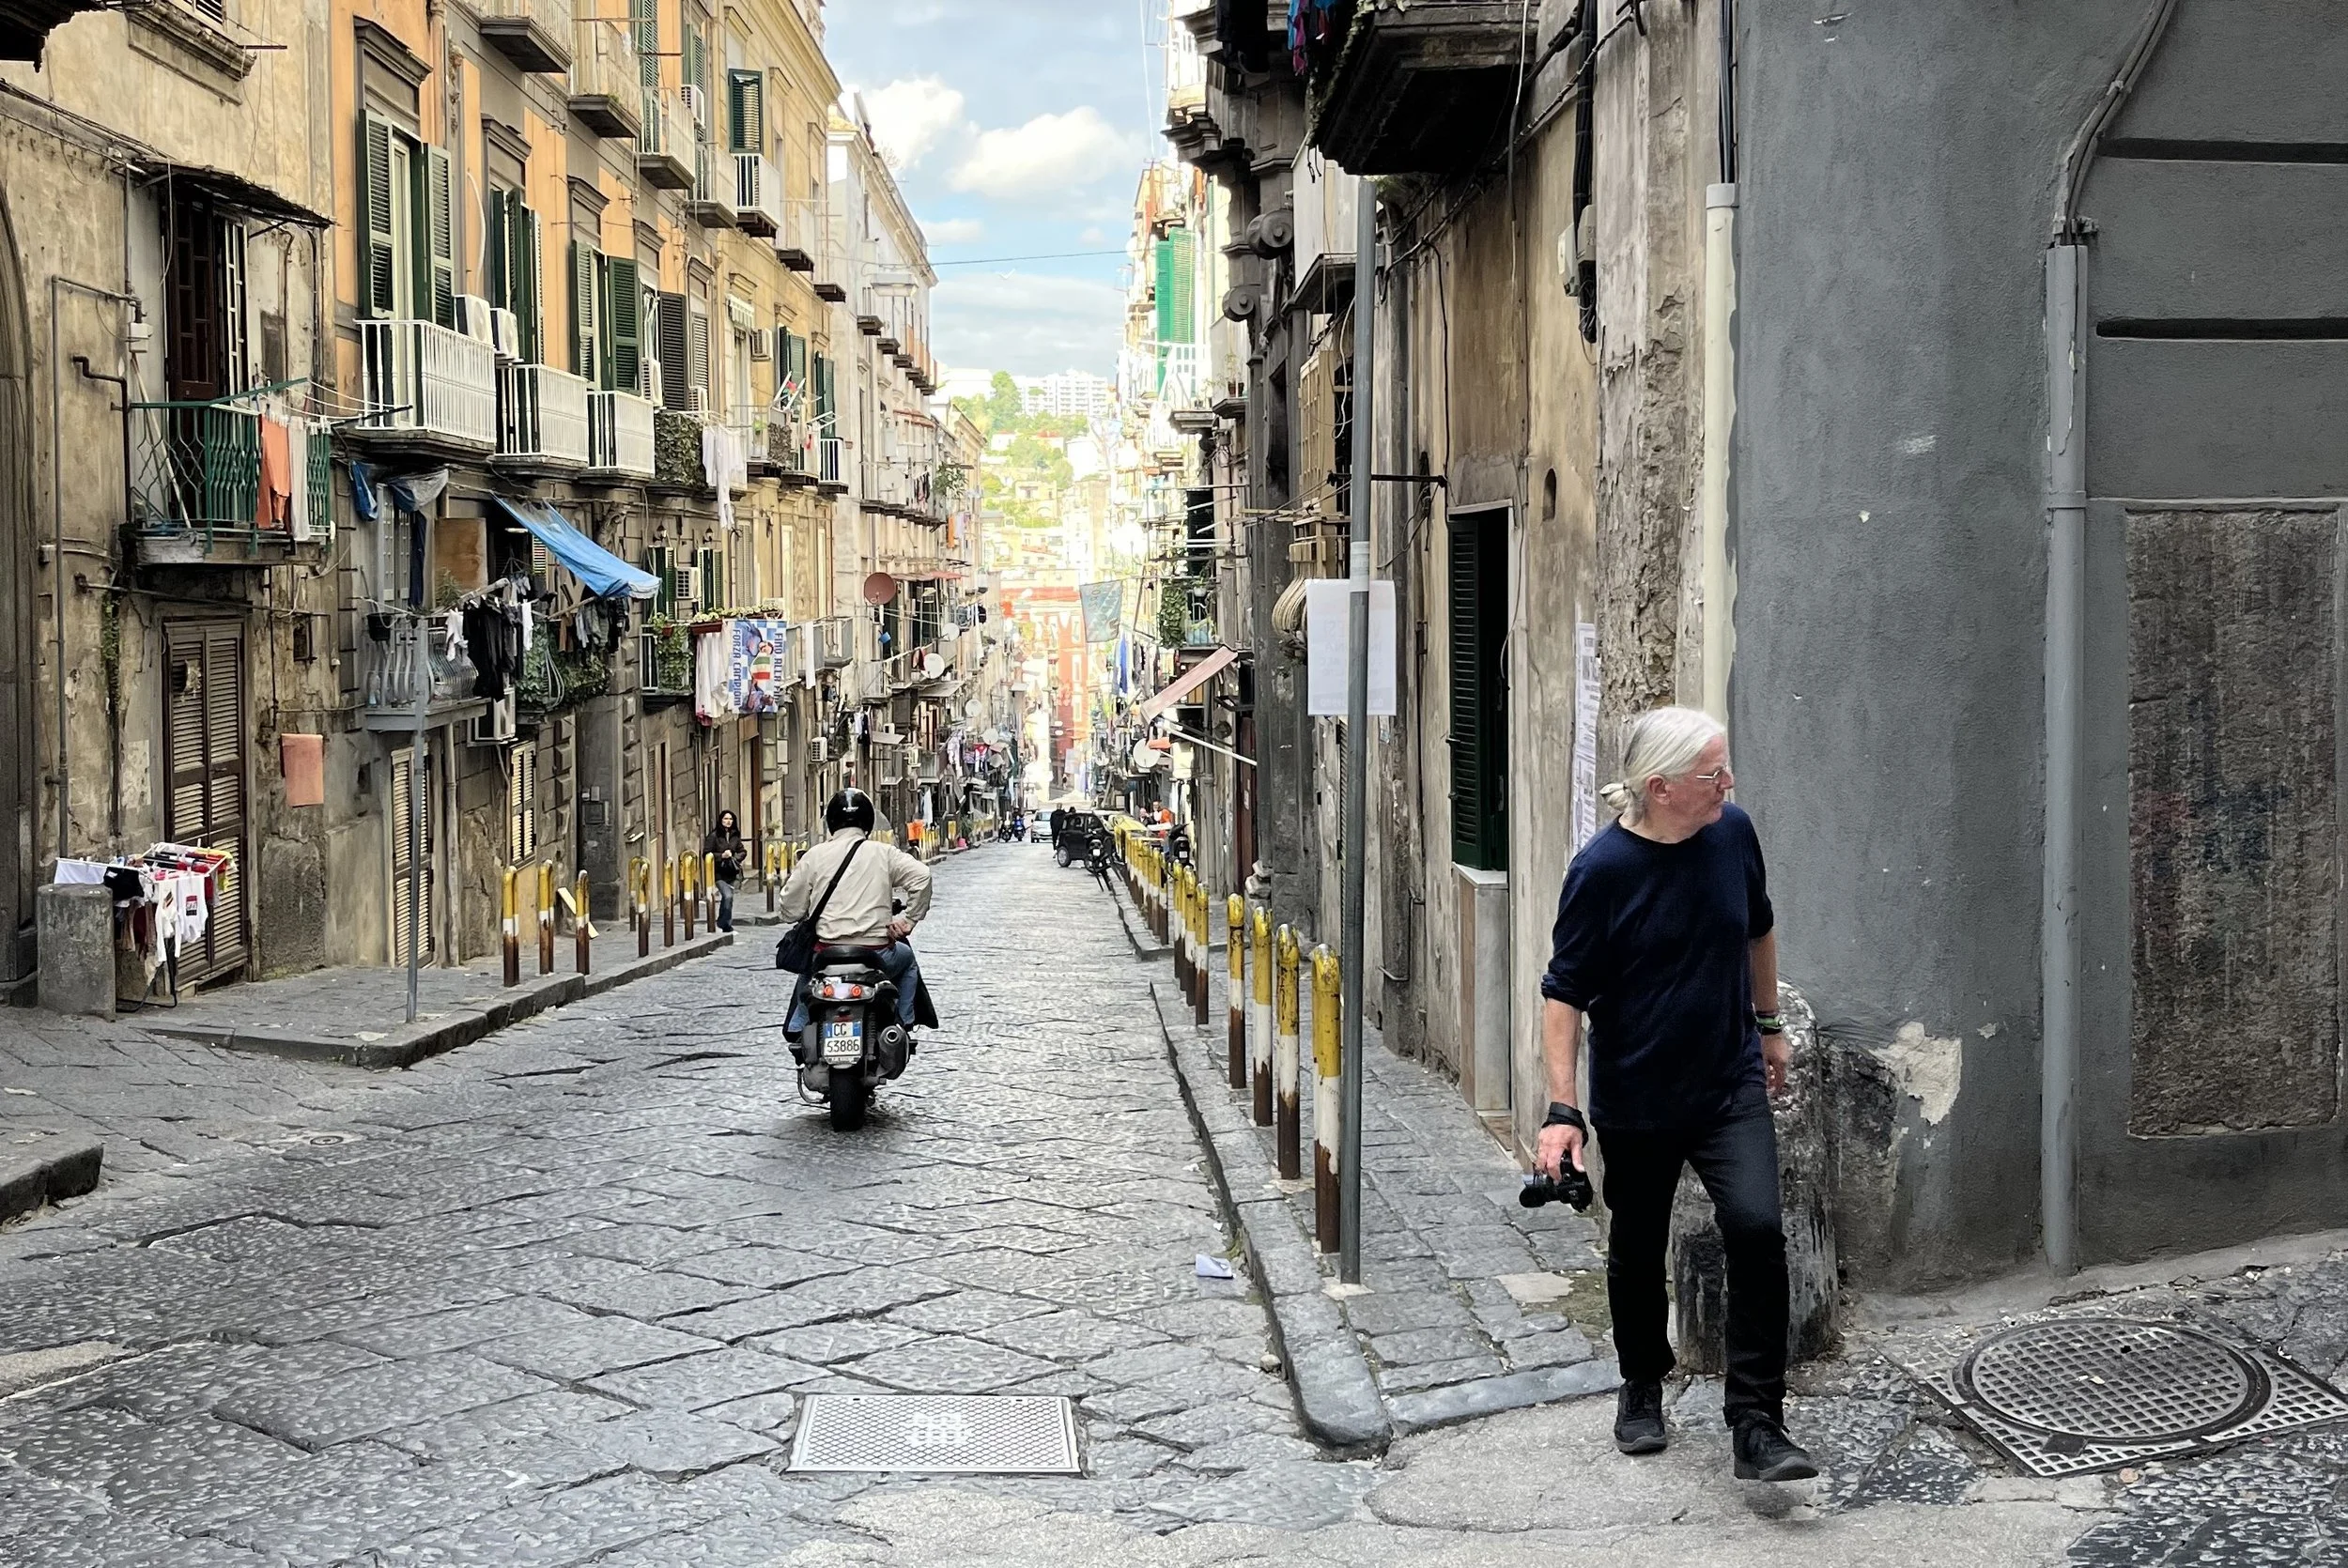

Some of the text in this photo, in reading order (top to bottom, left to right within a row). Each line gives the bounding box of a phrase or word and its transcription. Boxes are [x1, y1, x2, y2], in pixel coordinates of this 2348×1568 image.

[774, 633, 783, 654] FINO
[733, 629, 742, 706] FORZA CAMPIONI
[774, 658, 783, 682] ALLA
[826, 1039, 859, 1053] 53886
